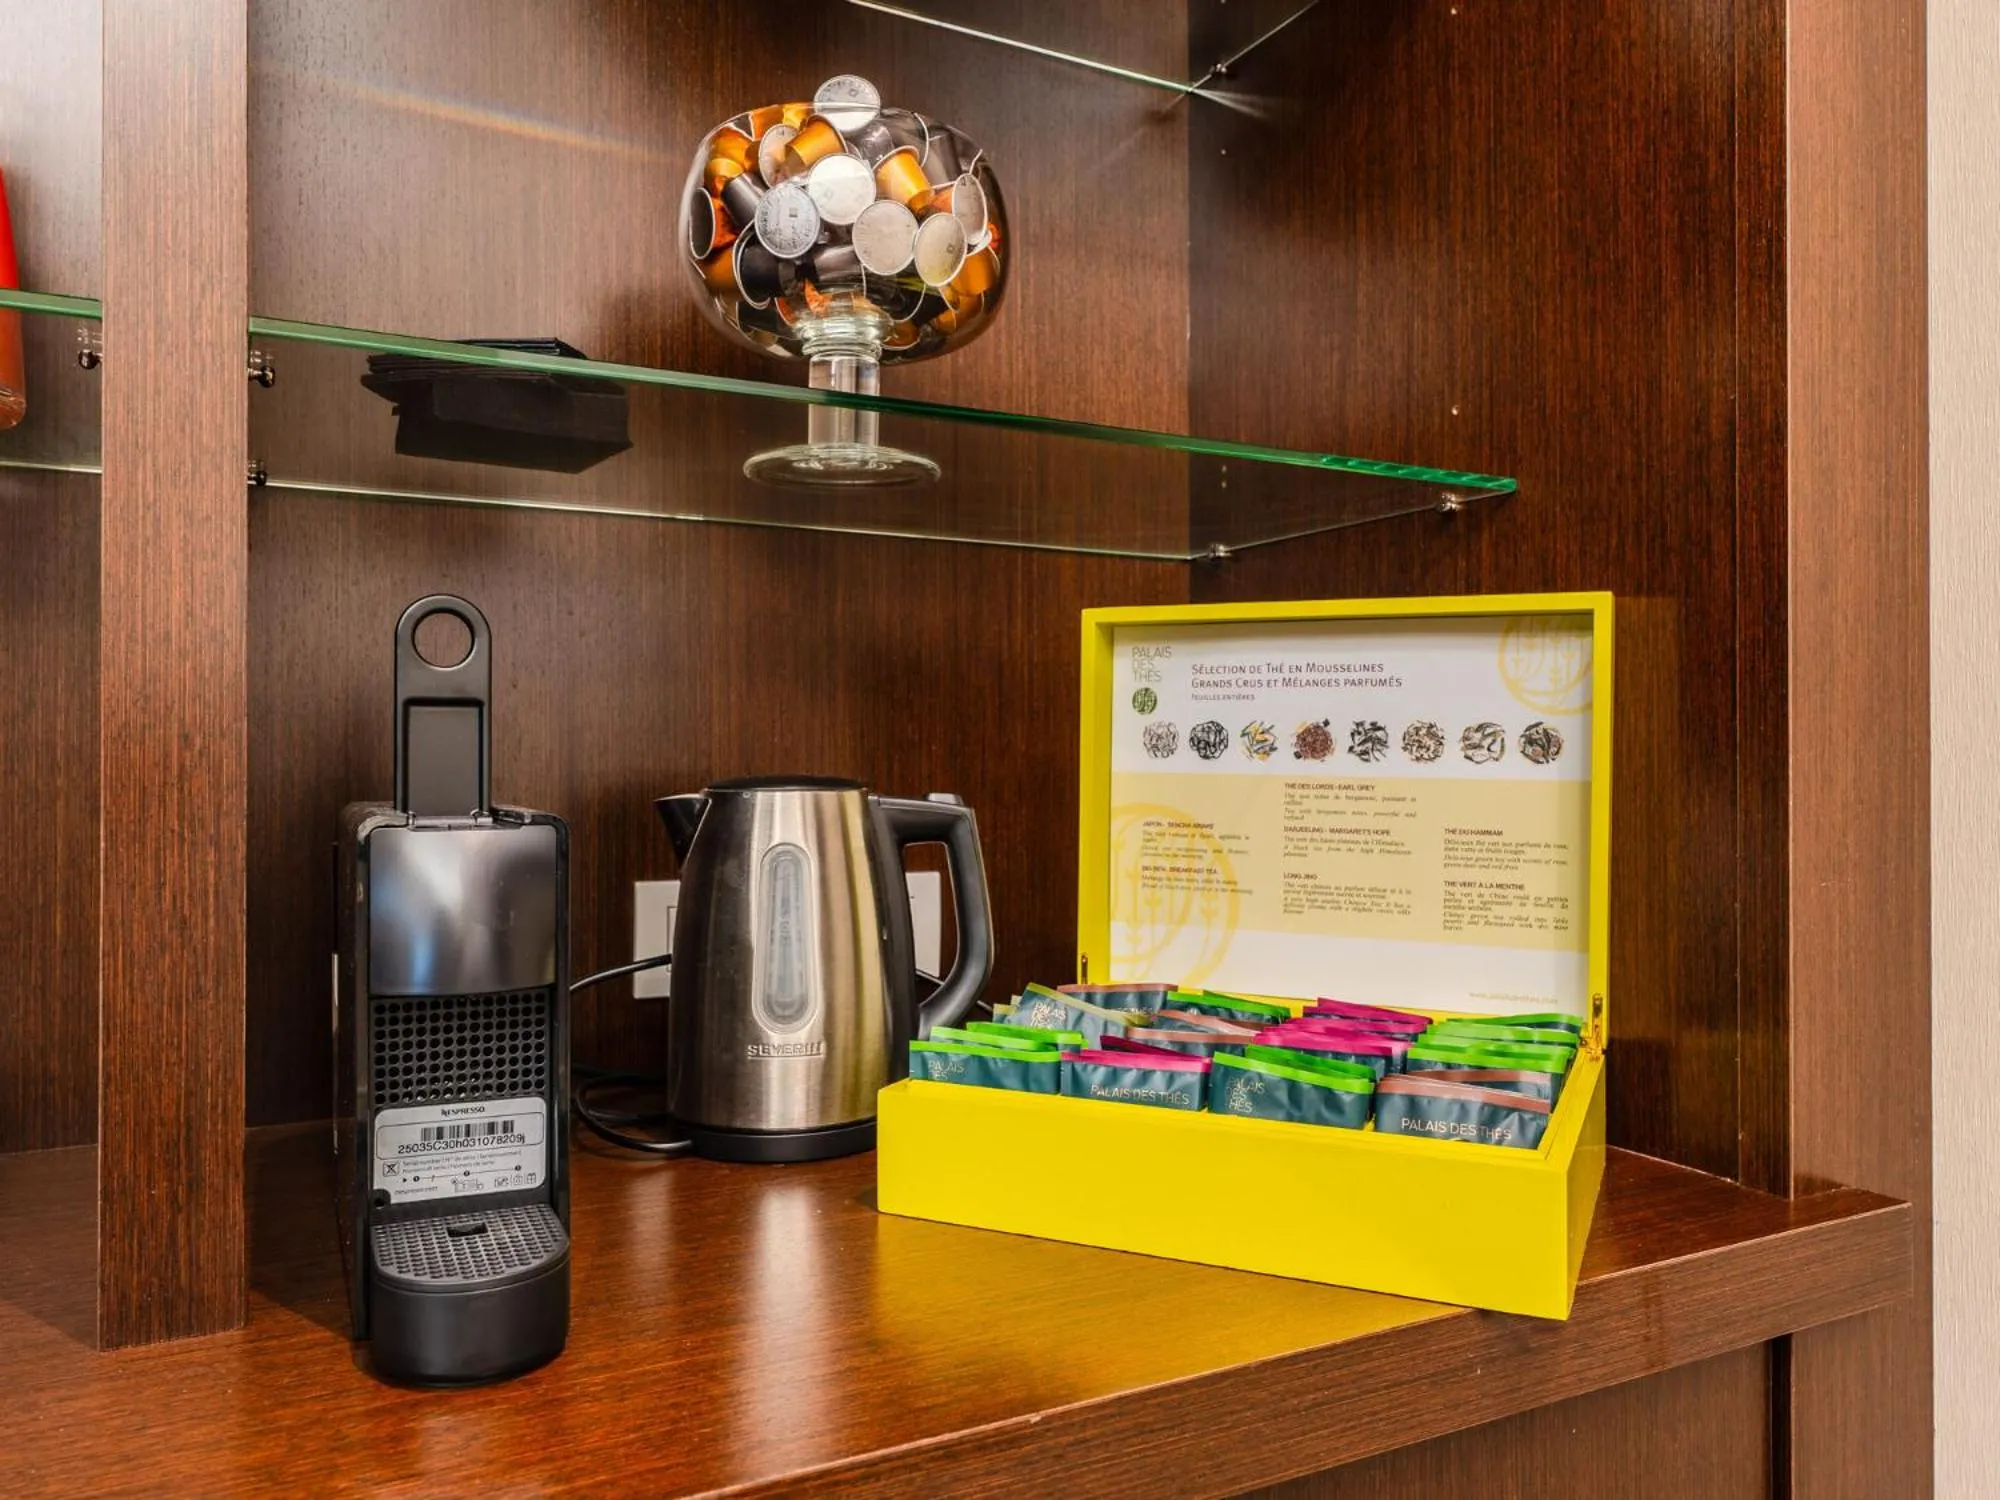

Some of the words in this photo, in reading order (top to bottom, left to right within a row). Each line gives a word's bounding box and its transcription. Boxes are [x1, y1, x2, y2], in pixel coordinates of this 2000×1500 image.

[1132, 646, 1172, 658] PALAIS
[1249, 665, 1261, 674] DE
[1266, 662, 1284, 674] THÉ
[1288, 664, 1302, 673] EN
[1191, 678, 1233, 689] GRANDS
[1235, 678, 1263, 688] CRUS
[1266, 679, 1278, 688] ET
[1091, 1083, 1130, 1098] PALAIS
[1133, 1088, 1156, 1101] DES
[441, 1106, 486, 1116] NESPRESSO
[1401, 1118, 1447, 1132] PALAIS
[1450, 1122, 1477, 1136] DES
